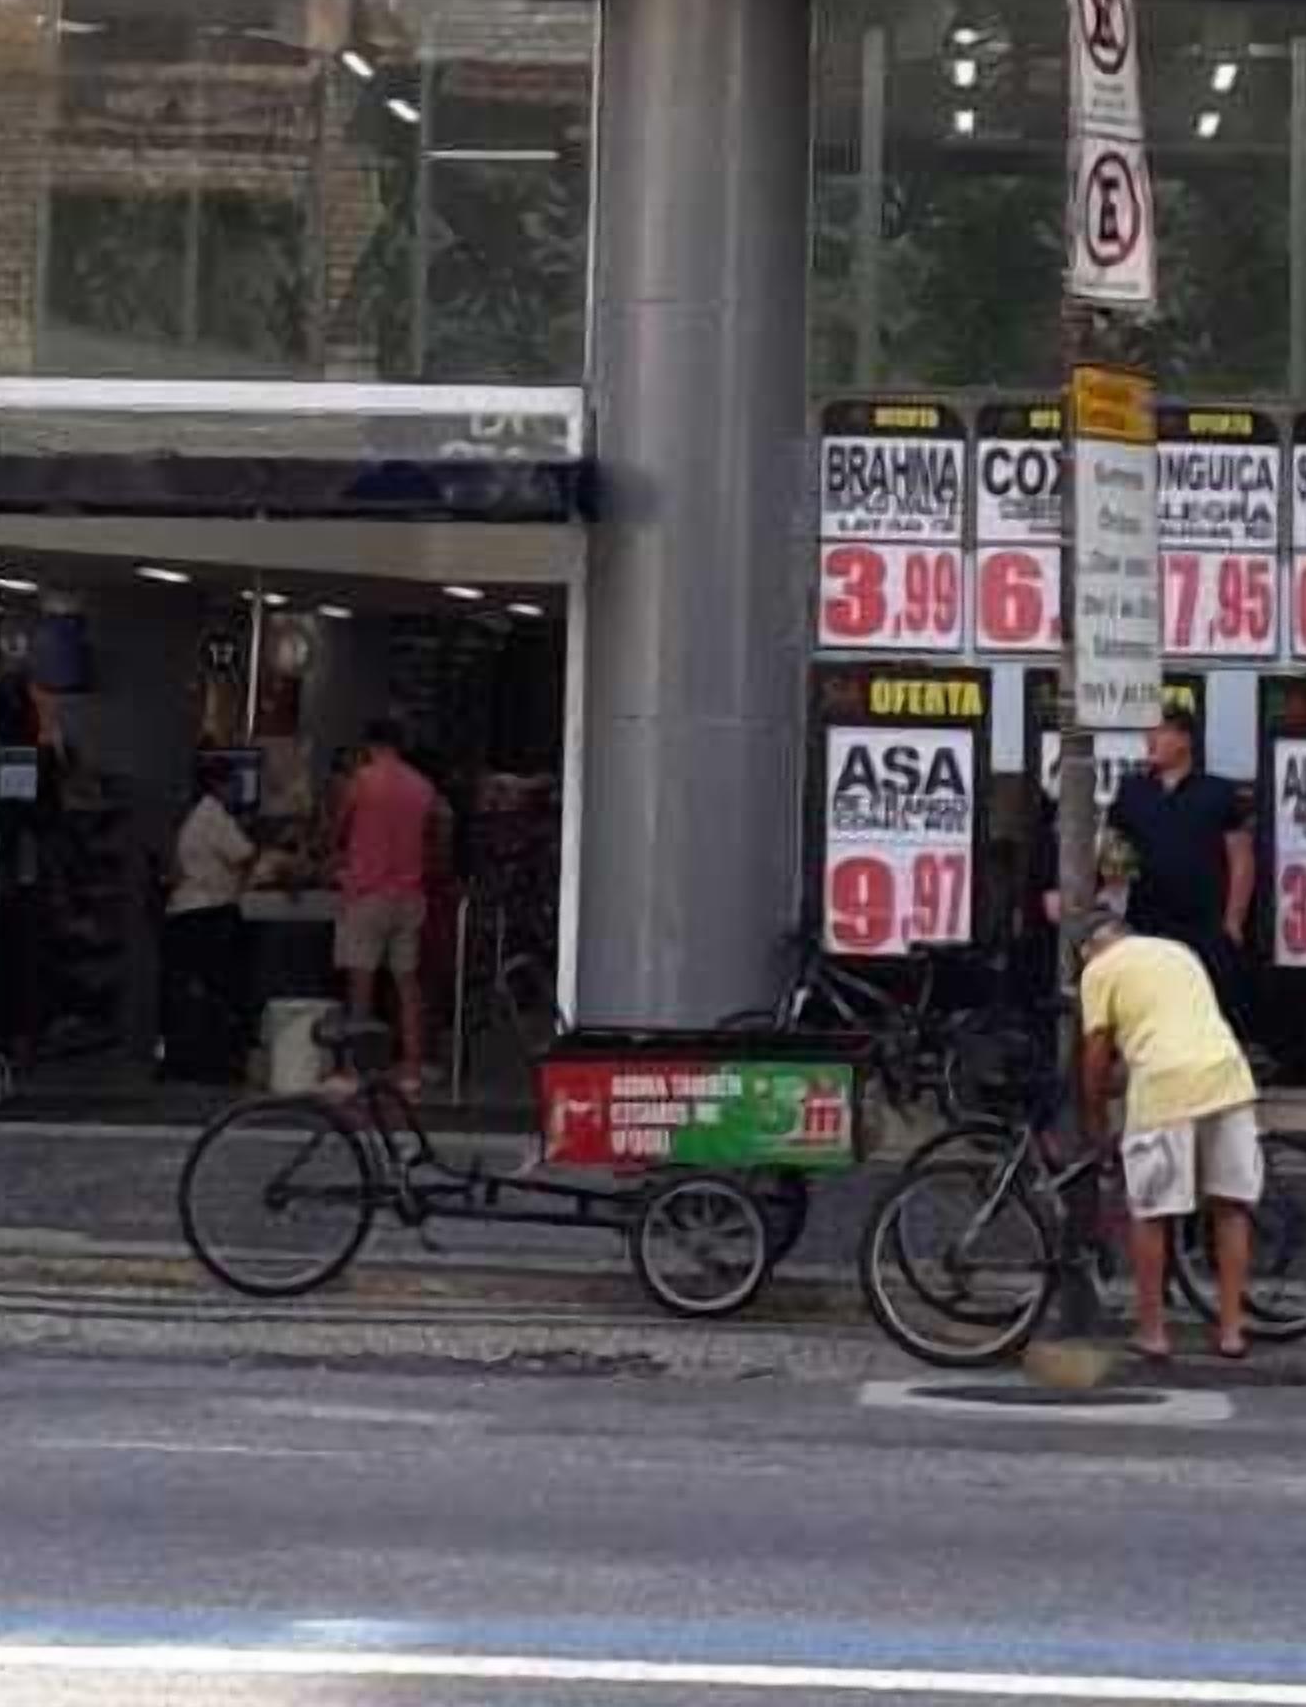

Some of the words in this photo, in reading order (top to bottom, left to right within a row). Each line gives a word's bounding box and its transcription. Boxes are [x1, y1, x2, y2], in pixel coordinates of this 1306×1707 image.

[827, 444, 959, 501] BRAHMA
[825, 545, 959, 639] 3,99
[836, 744, 966, 796] ASA
[831, 851, 966, 947] 9,97
